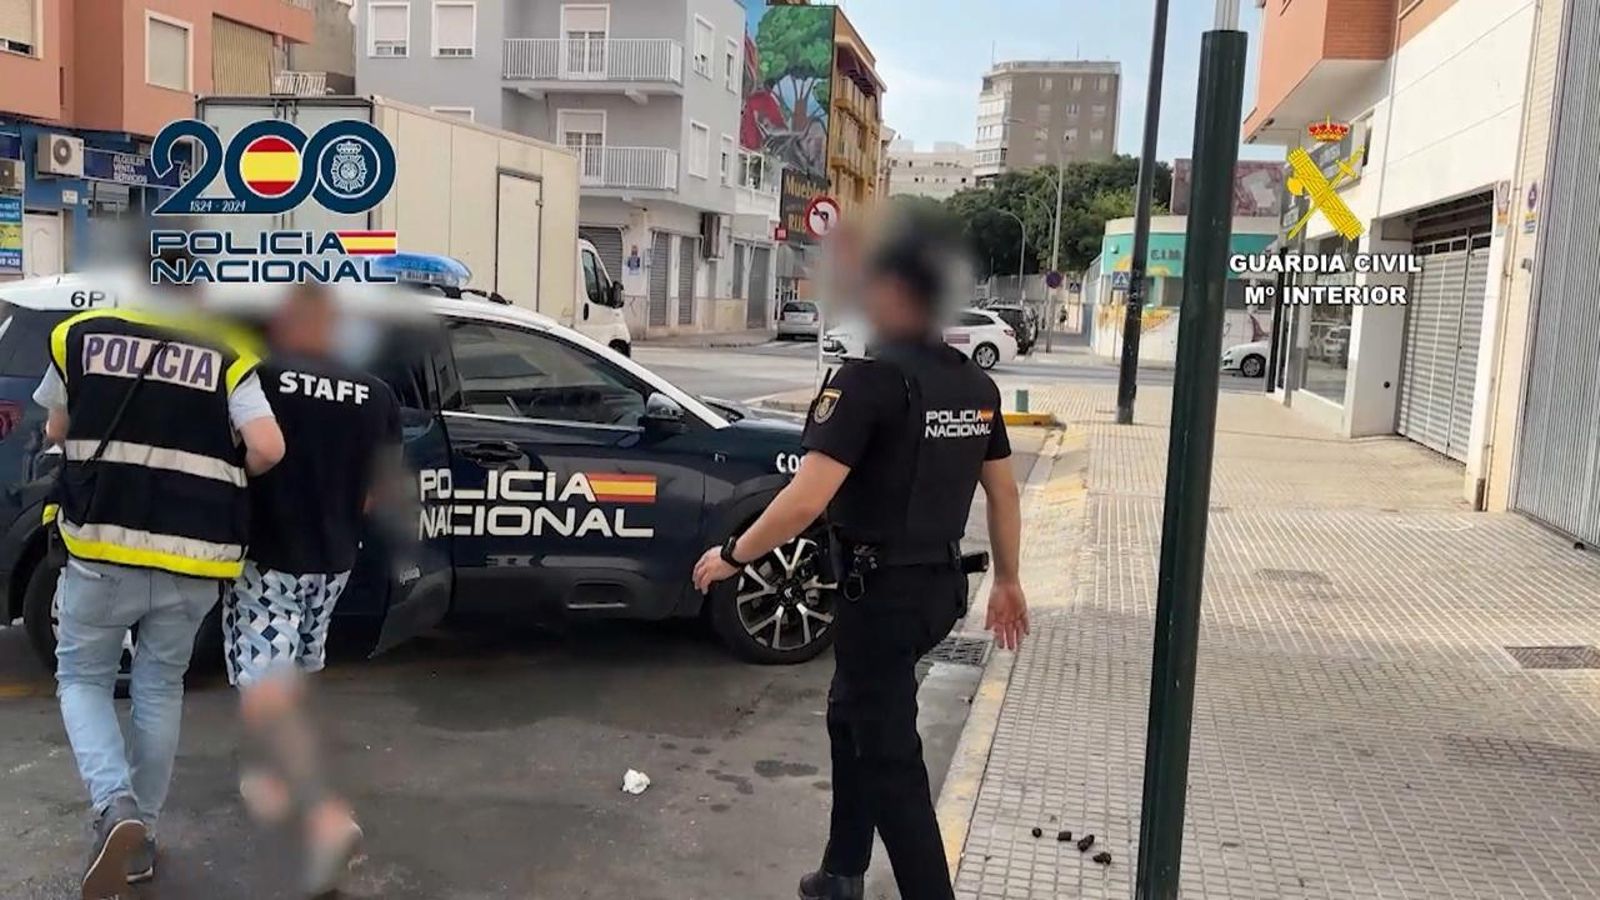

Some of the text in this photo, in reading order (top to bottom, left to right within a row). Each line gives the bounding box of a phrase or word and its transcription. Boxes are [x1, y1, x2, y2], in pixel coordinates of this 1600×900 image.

[85, 336, 213, 388] POLICIA
[279, 370, 370, 405] STAFF
[925, 423, 992, 438] NACIONAL
[776, 452, 805, 473] CO
[418, 503, 655, 541] NACIONAL
